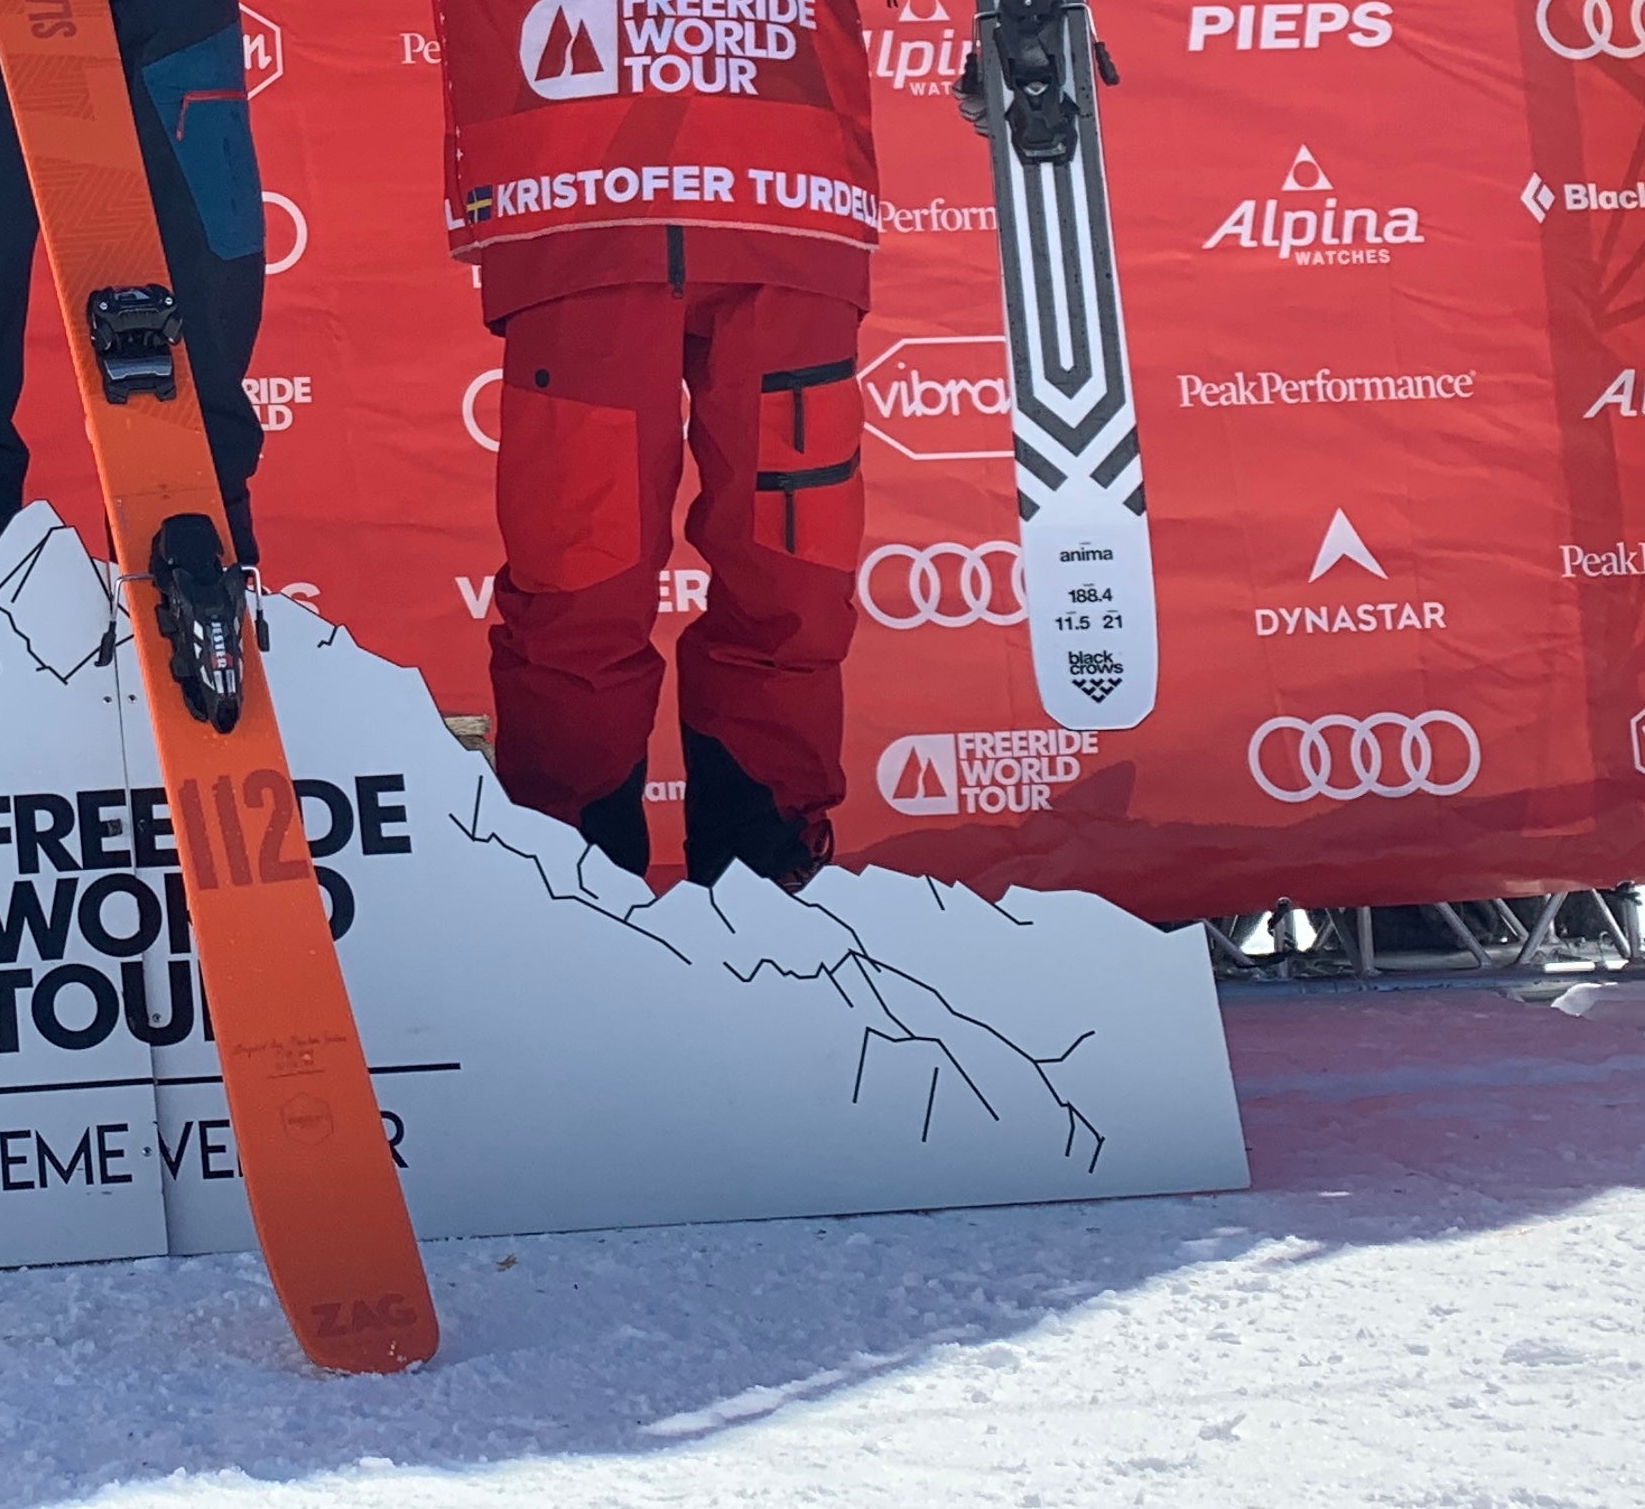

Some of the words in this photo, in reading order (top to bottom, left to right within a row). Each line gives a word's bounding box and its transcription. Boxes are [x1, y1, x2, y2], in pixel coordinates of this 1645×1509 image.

[622, 17, 797, 62] WORLD
[1188, 1, 1393, 52] PIEPS
[622, 53, 760, 96] TOUR
[497, 165, 735, 218] KRISTOFER
[1202, 197, 1425, 264] Alpina
[1294, 248, 1391, 266] WATCHES
[870, 361, 1012, 419] vibra
[1059, 546, 1114, 563] anima
[1068, 588, 1113, 604] 188.4
[1056, 616, 1091, 631] 11.5
[1102, 615, 1124, 630] 21
[1254, 601, 1447, 636] DYNASTAR
[1068, 649, 1114, 666] black
[1069, 661, 1124, 676] crows
[955, 727, 1102, 759] FREERIDE
[959, 755, 1081, 787] WORLD
[960, 784, 1052, 814] TOUR
[177, 769, 313, 890] 112
[310, 1292, 418, 1338] ZAG
